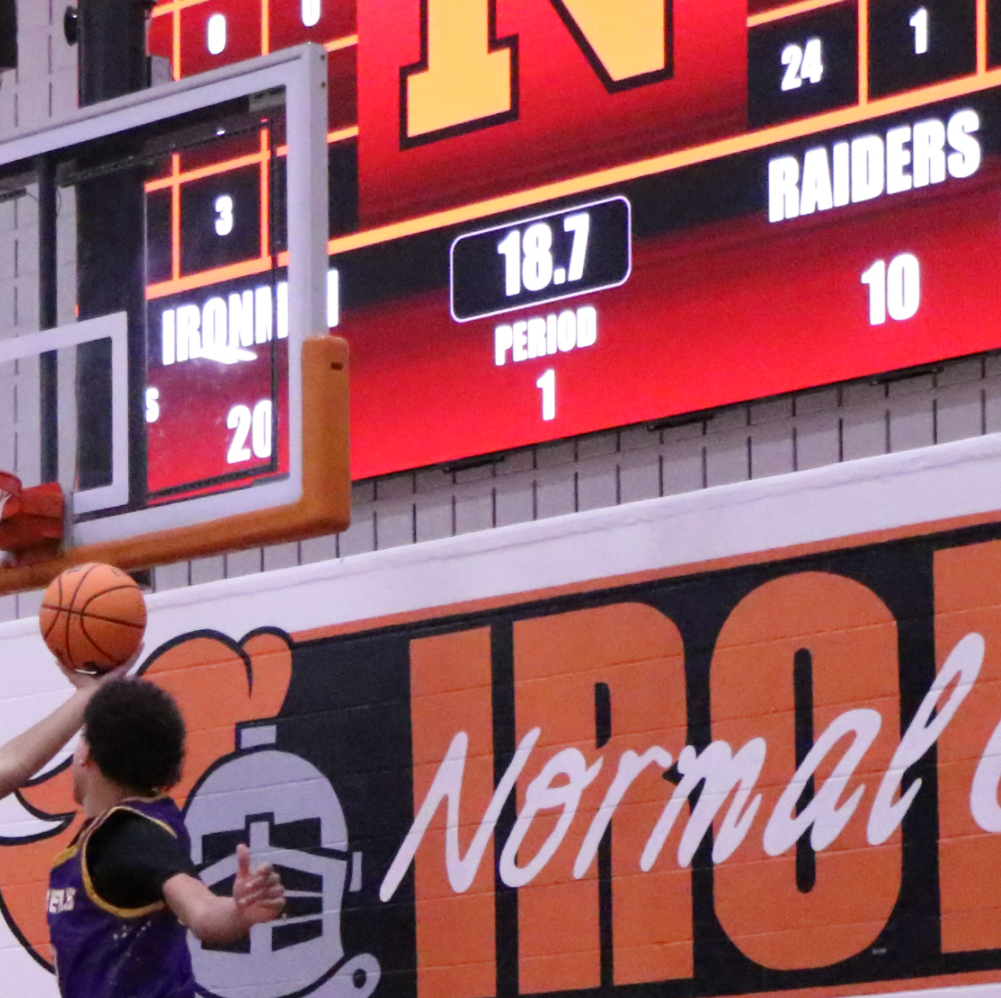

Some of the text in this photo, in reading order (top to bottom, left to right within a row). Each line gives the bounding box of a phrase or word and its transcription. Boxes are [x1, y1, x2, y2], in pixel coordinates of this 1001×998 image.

[207, 13, 227, 55] 0
[909, 7, 927, 54] 1
[780, 37, 824, 91] 24
[767, 108, 981, 223] RAIDERS
[214, 194, 235, 237] 3
[497, 212, 590, 297] 18.7
[162, 268, 339, 366] IRONM
[860, 252, 921, 326] 10
[494, 305, 598, 366] PERIOD
[536, 369, 556, 421] 1
[227, 399, 272, 464] 20
[379, 632, 985, 902] Normal
